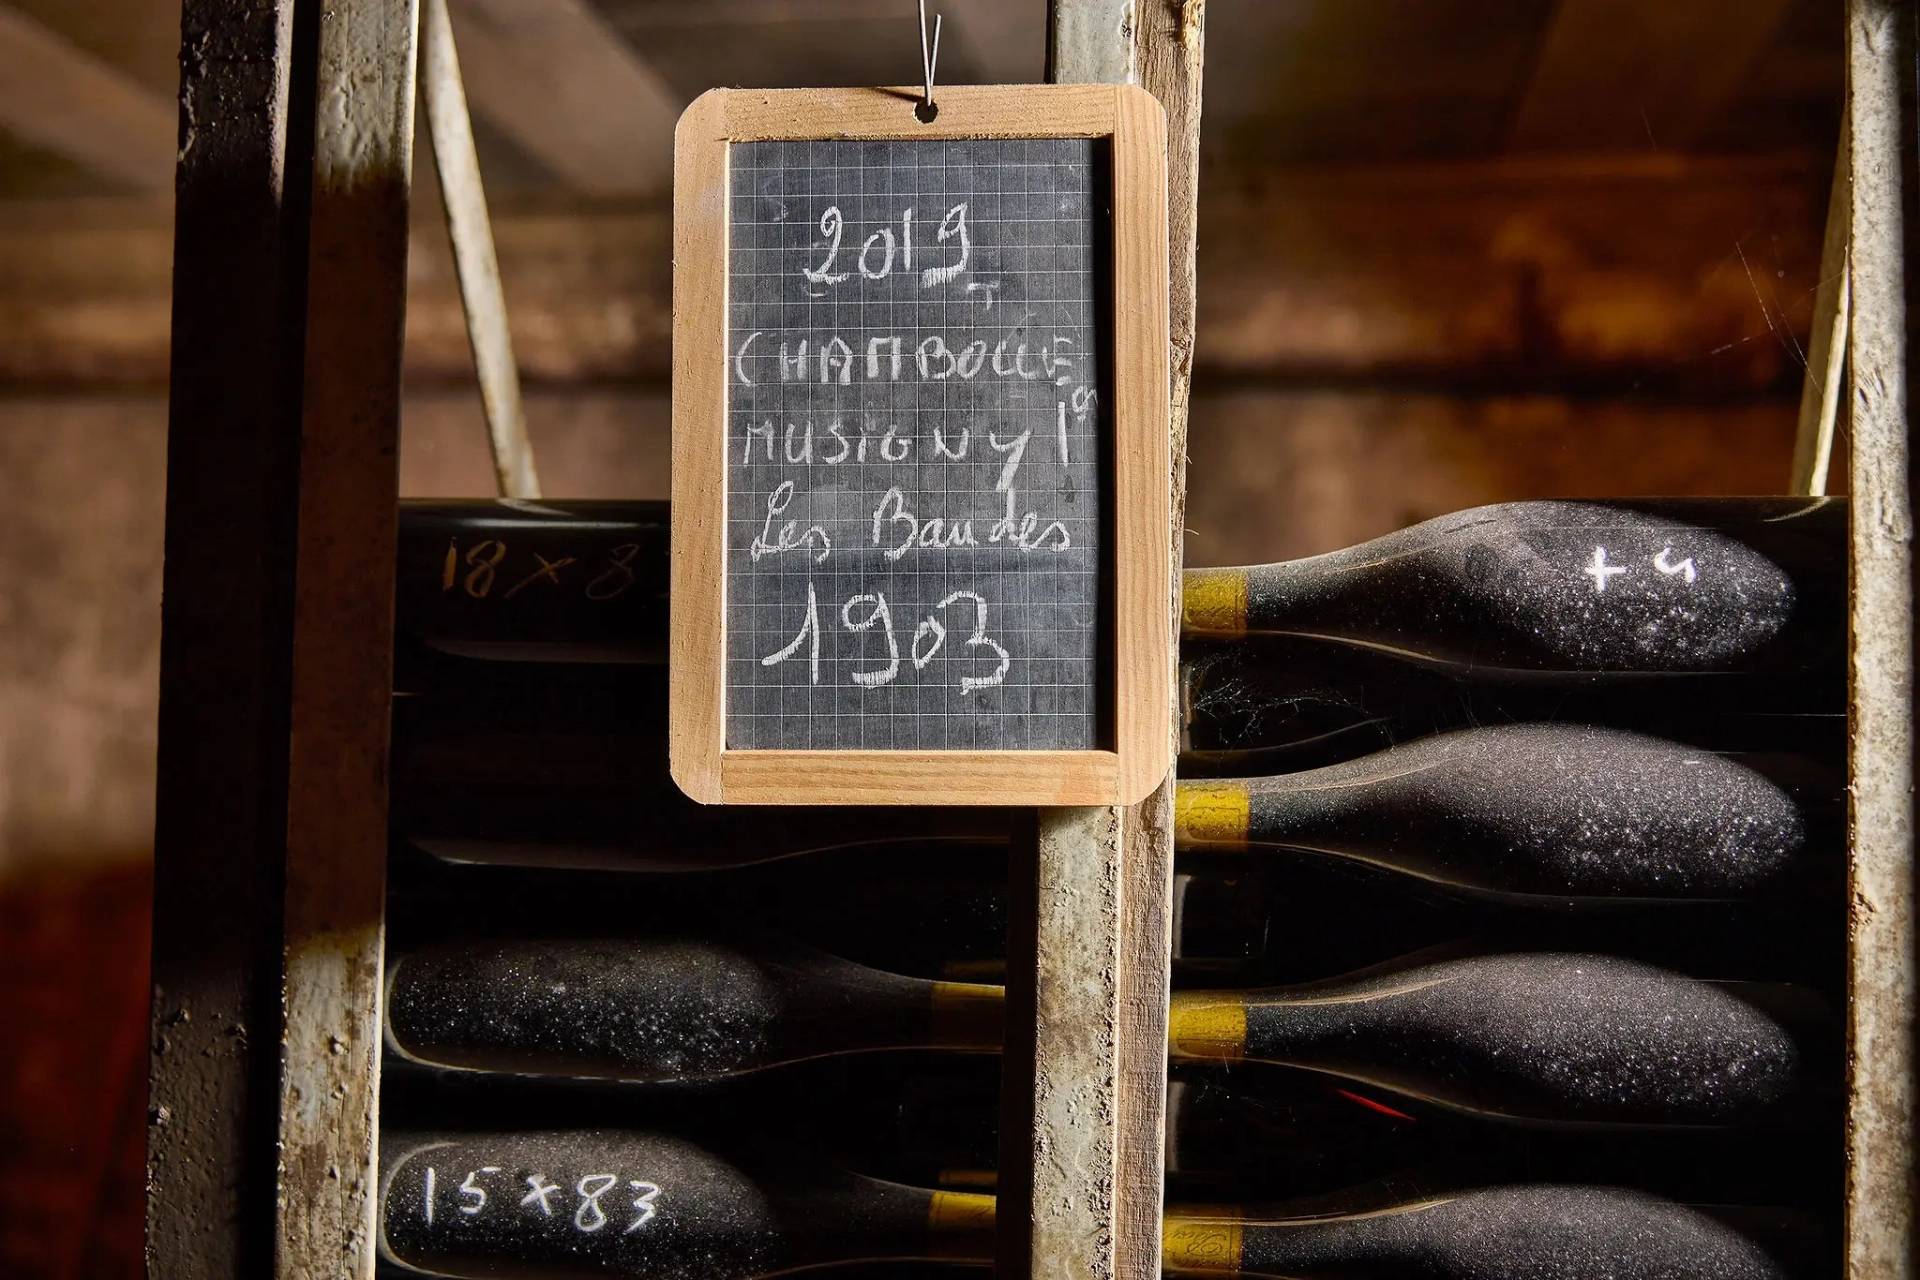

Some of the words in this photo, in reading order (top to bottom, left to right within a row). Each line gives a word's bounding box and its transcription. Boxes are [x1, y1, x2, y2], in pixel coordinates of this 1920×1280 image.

[803, 202, 971, 288] 2019
[751, 481, 831, 564] Les
[872, 487, 1071, 562] Baudes
[443, 537, 506, 599] 18
[761, 581, 1010, 695] 1903
[423, 1167, 502, 1229] 15
[573, 1173, 662, 1236] 83
